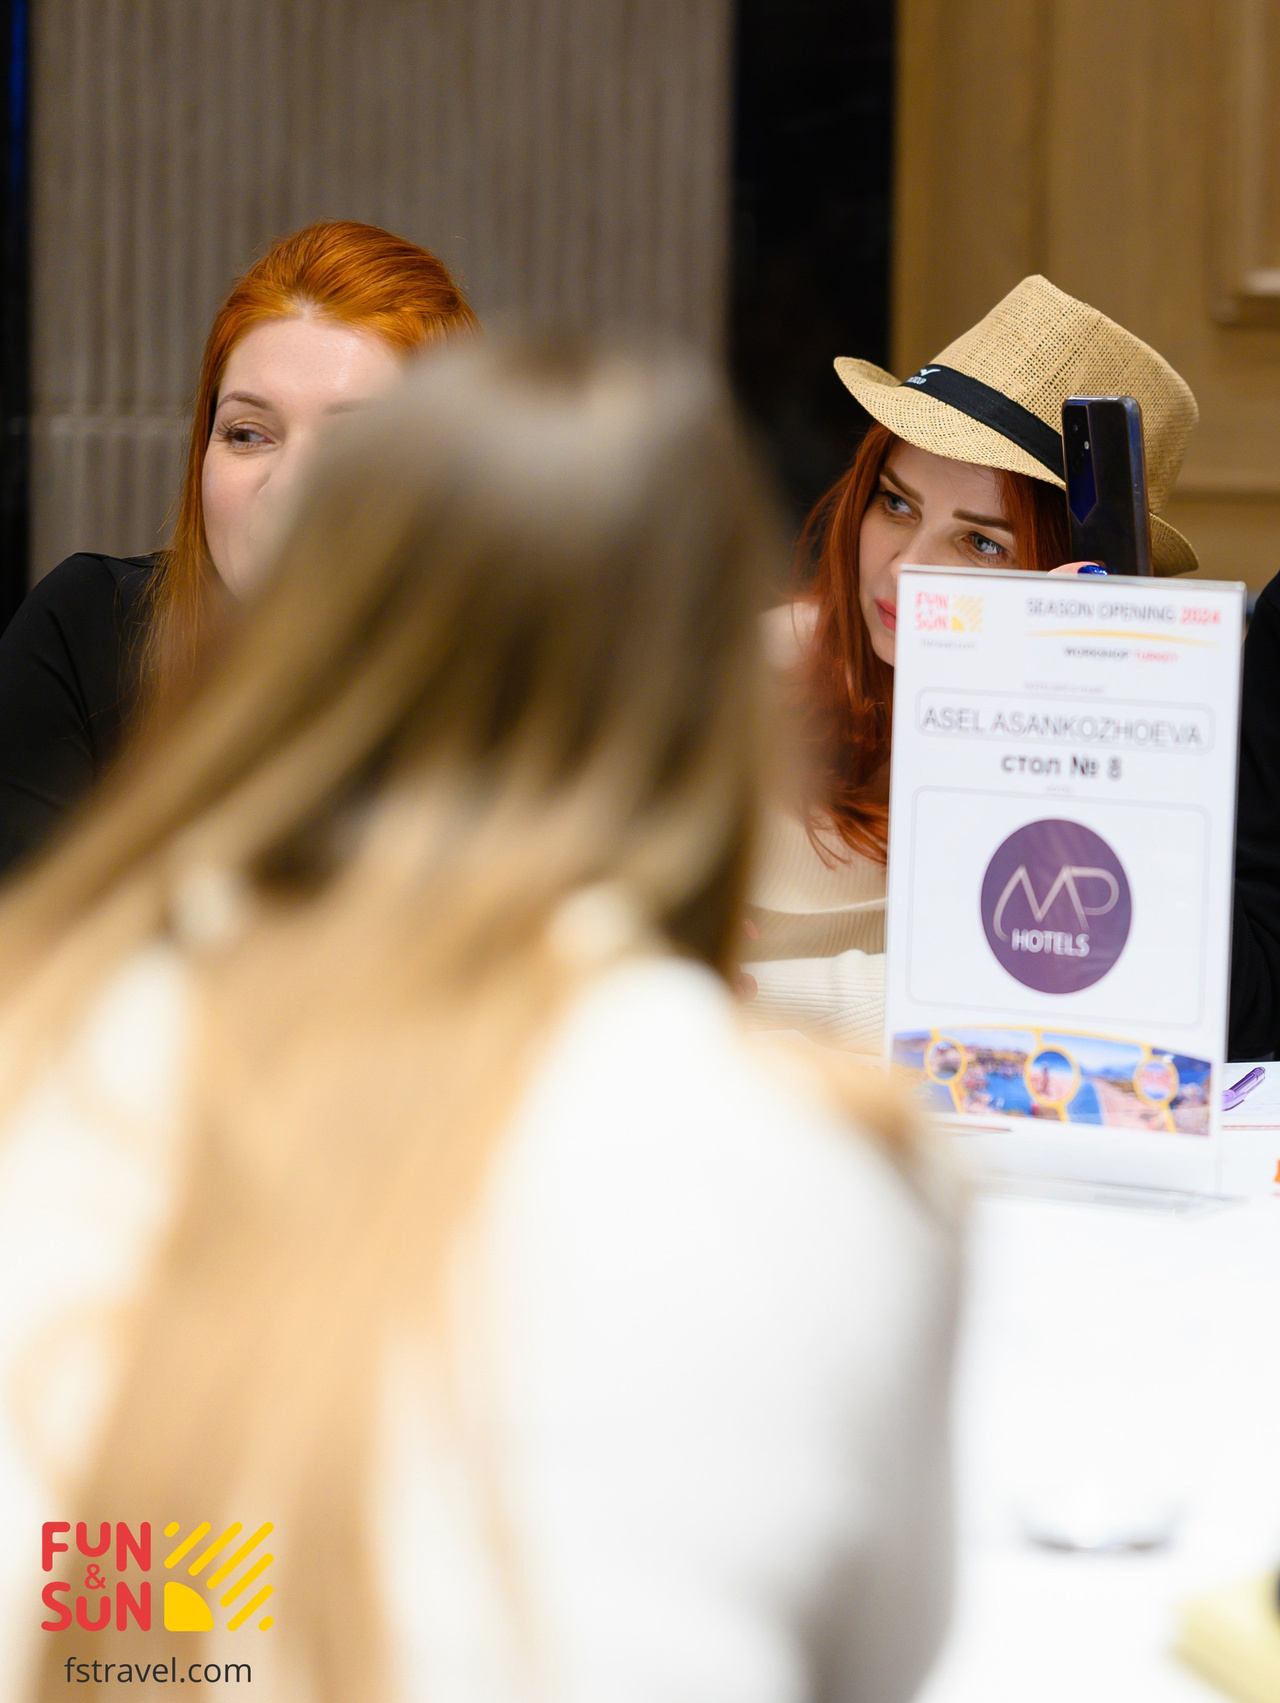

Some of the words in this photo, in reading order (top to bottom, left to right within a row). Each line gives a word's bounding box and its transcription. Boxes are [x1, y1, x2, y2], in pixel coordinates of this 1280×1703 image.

[915, 592, 949, 609] FUN
[1026, 598, 1094, 618] SEASON
[1097, 601, 1177, 624] OPENING
[922, 706, 985, 734] ASEL
[990, 710, 1203, 748] ASANKOZHOEVA
[1107, 756, 1123, 781] 8
[1011, 928, 1090, 958] HOTELS
